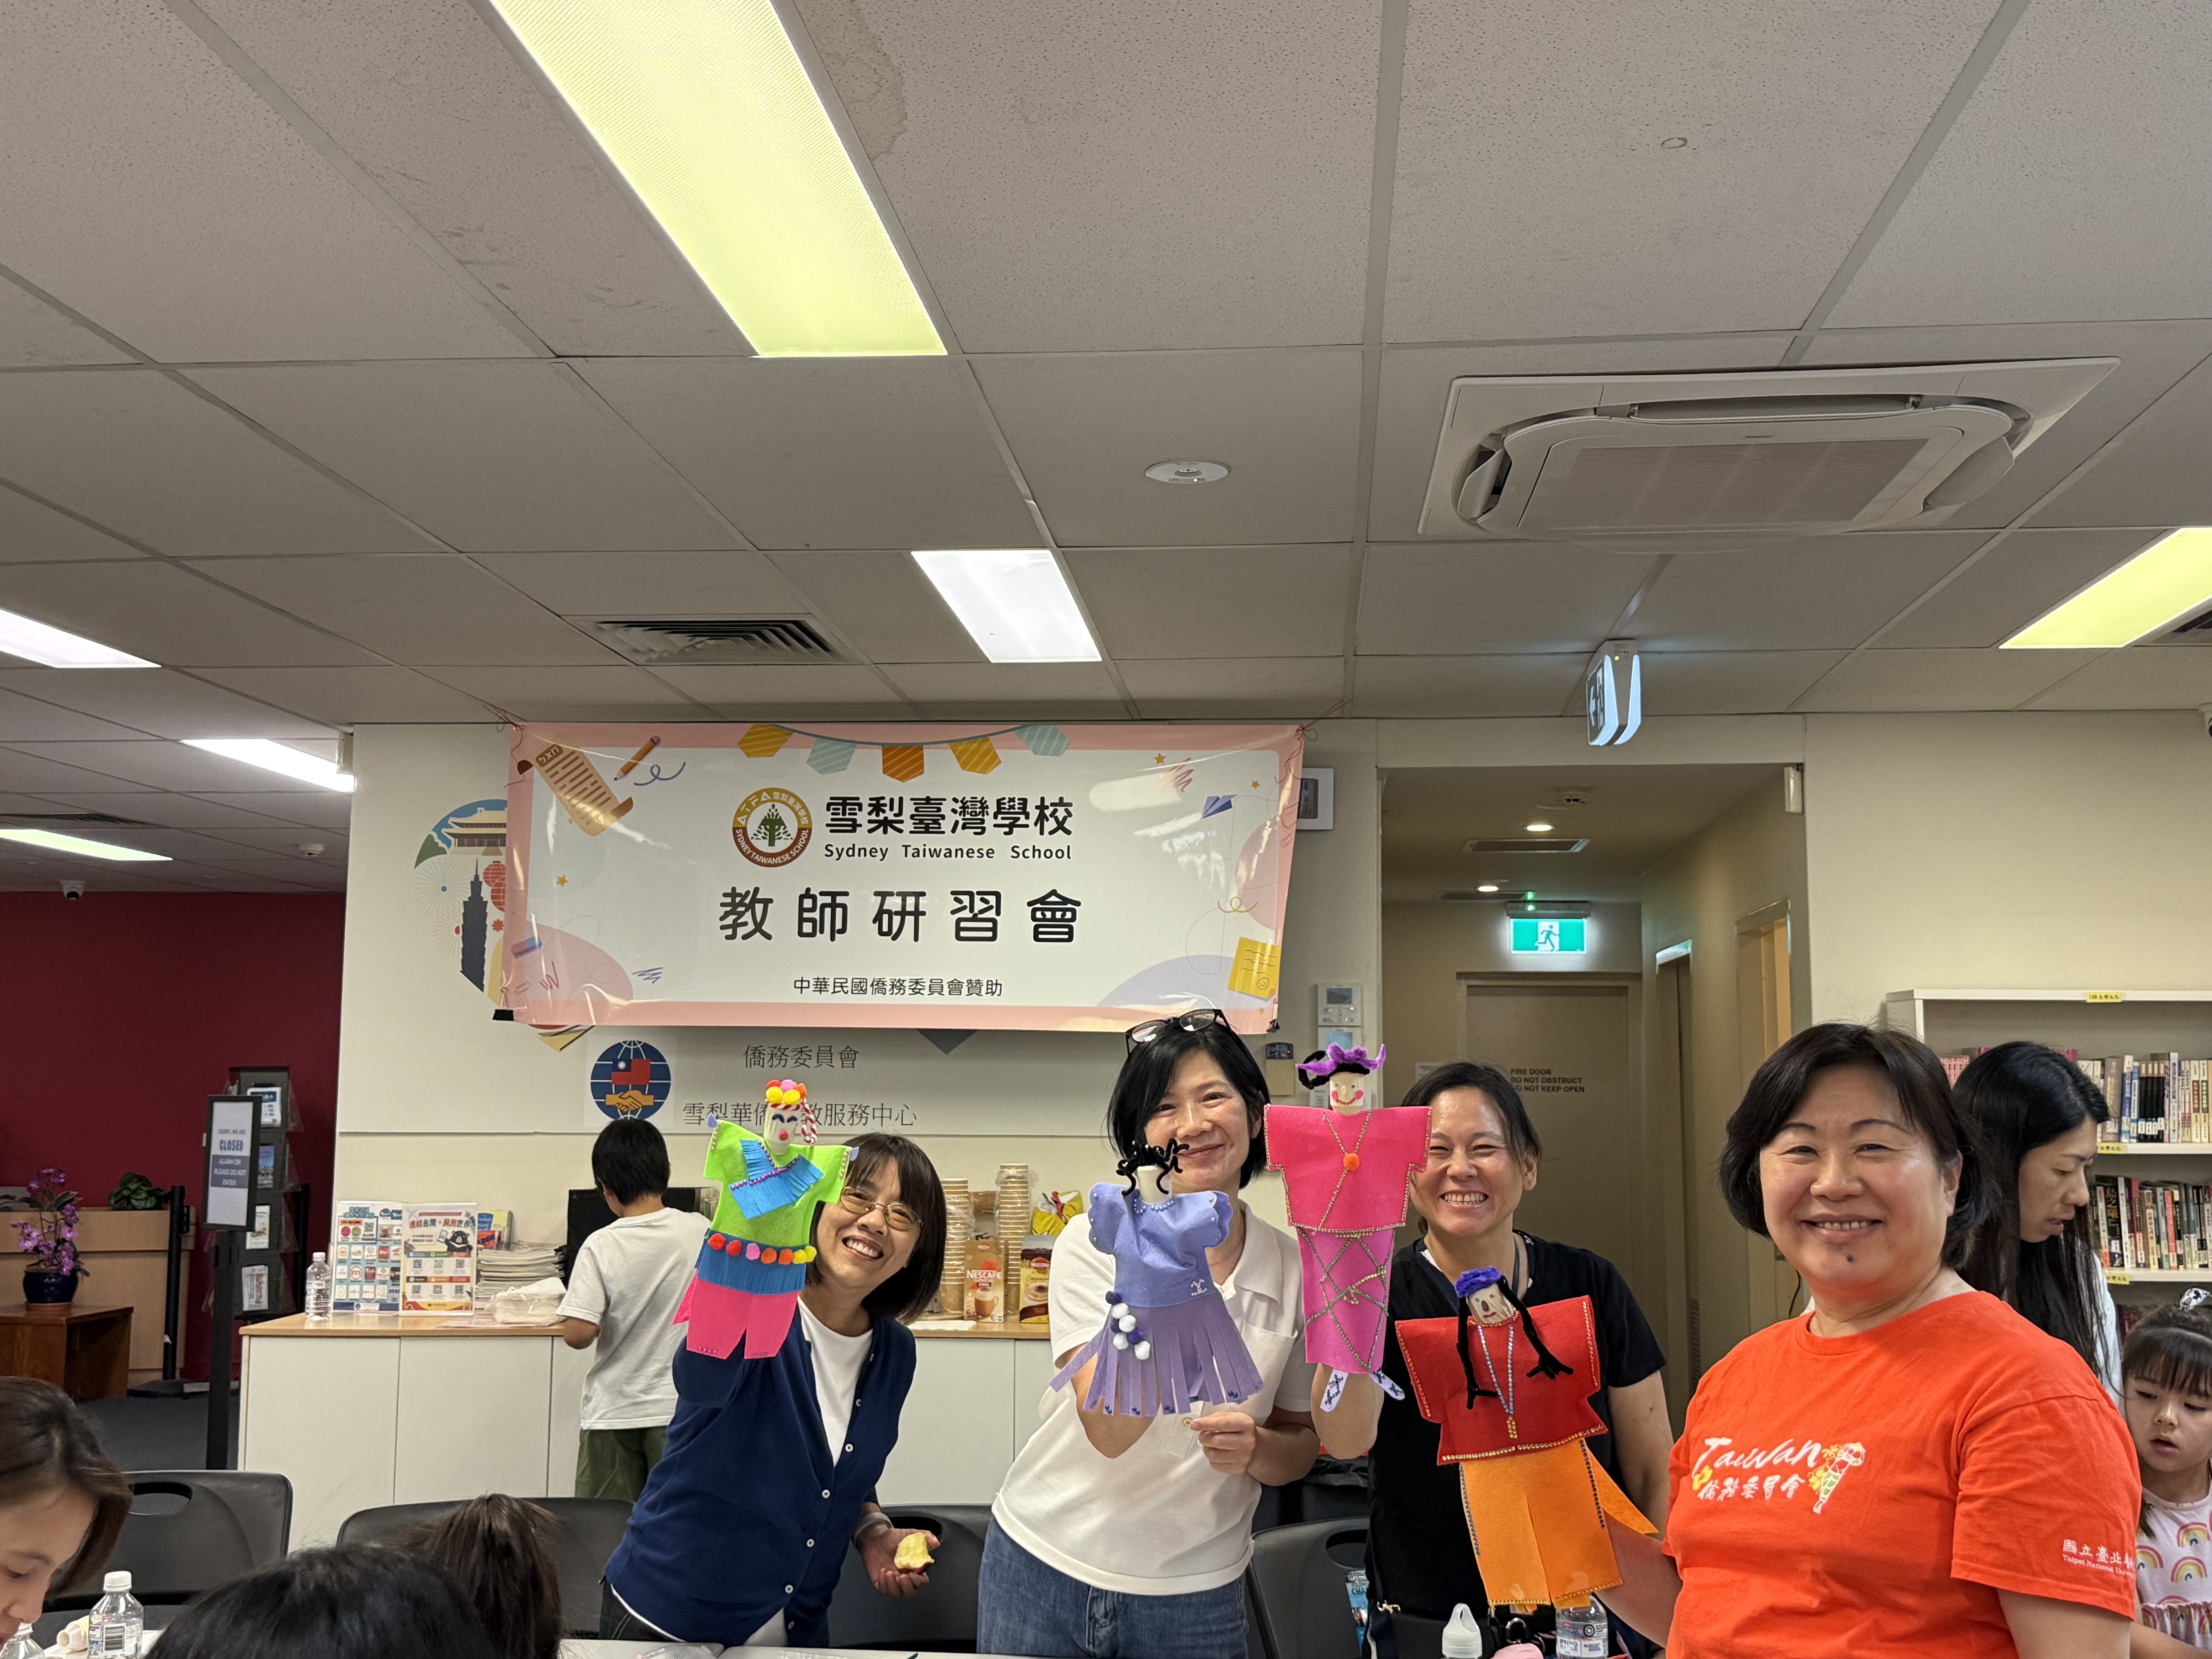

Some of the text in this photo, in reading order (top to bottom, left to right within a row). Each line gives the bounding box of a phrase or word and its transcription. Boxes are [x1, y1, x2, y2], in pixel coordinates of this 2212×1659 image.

[825, 795, 1073, 836] 雪梨臺灣學校
[736, 828, 809, 864] SYDNEY TAIWANESE SCHOOL
[824, 843, 1071, 861] Sydney Taiwanese School
[719, 886, 1082, 943] 教師研習會
[793, 976, 1002, 996] 中華民國僑務委員會贊助
[744, 1045, 859, 1069] 僑務委員會
[683, 1102, 917, 1127] 雪梨華僑教服務中心
[220, 1139, 244, 1151] CLOSED
[1691, 1437, 1822, 1479] Taiwan
[1697, 1474, 1805, 1501] 僑務委員會
[2063, 1554, 2085, 1565] Taipei
[2087, 1560, 2114, 1573] National
